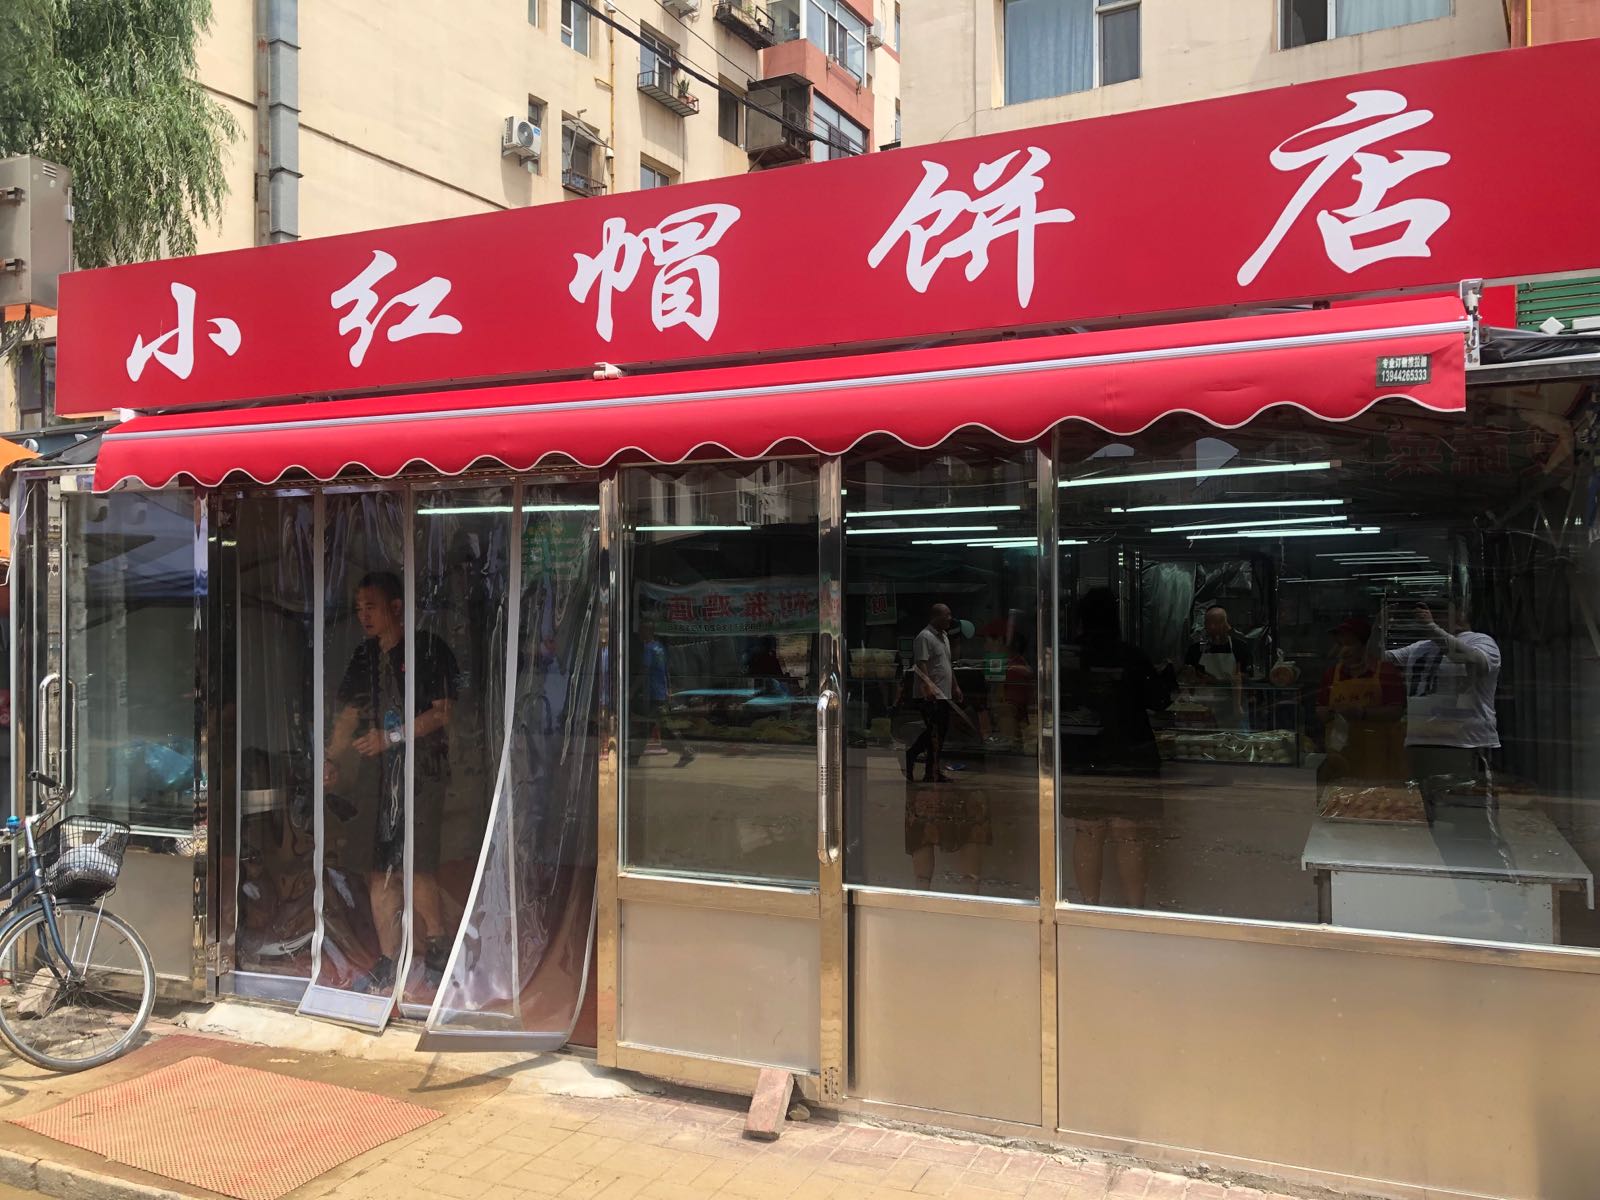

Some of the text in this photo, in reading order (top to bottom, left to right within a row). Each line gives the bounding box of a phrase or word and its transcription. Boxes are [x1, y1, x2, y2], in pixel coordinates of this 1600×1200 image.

[126, 89, 1451, 382] 小红帽饼店
[1381, 369, 1427, 382] 13944265333
